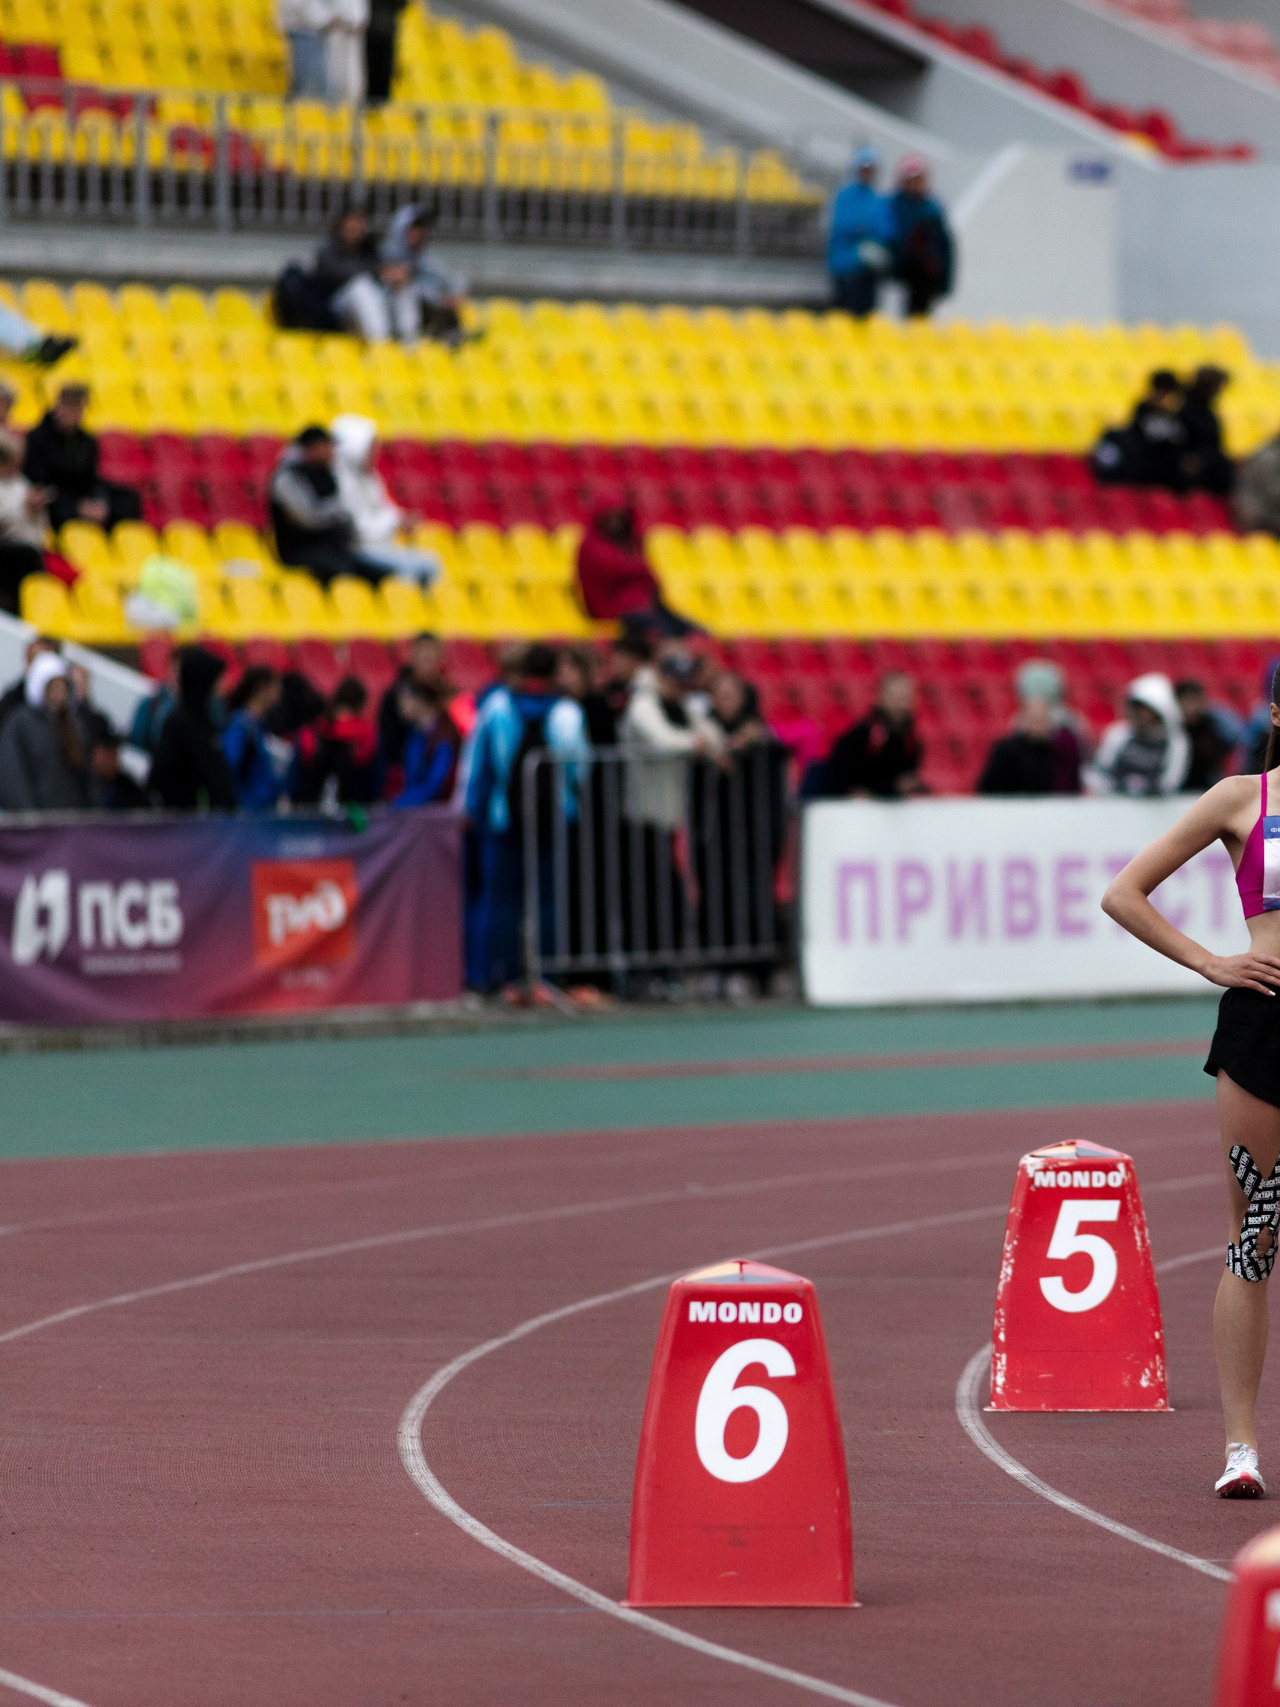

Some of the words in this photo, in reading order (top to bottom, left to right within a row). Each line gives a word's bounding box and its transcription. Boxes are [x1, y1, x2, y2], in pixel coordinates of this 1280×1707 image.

[77, 878, 184, 951] ПСБ
[1033, 1170, 1123, 1189] MONDO
[1039, 1200, 1121, 1313] 5
[689, 1301, 803, 1324] MONDO
[695, 1338, 797, 1483] 6
